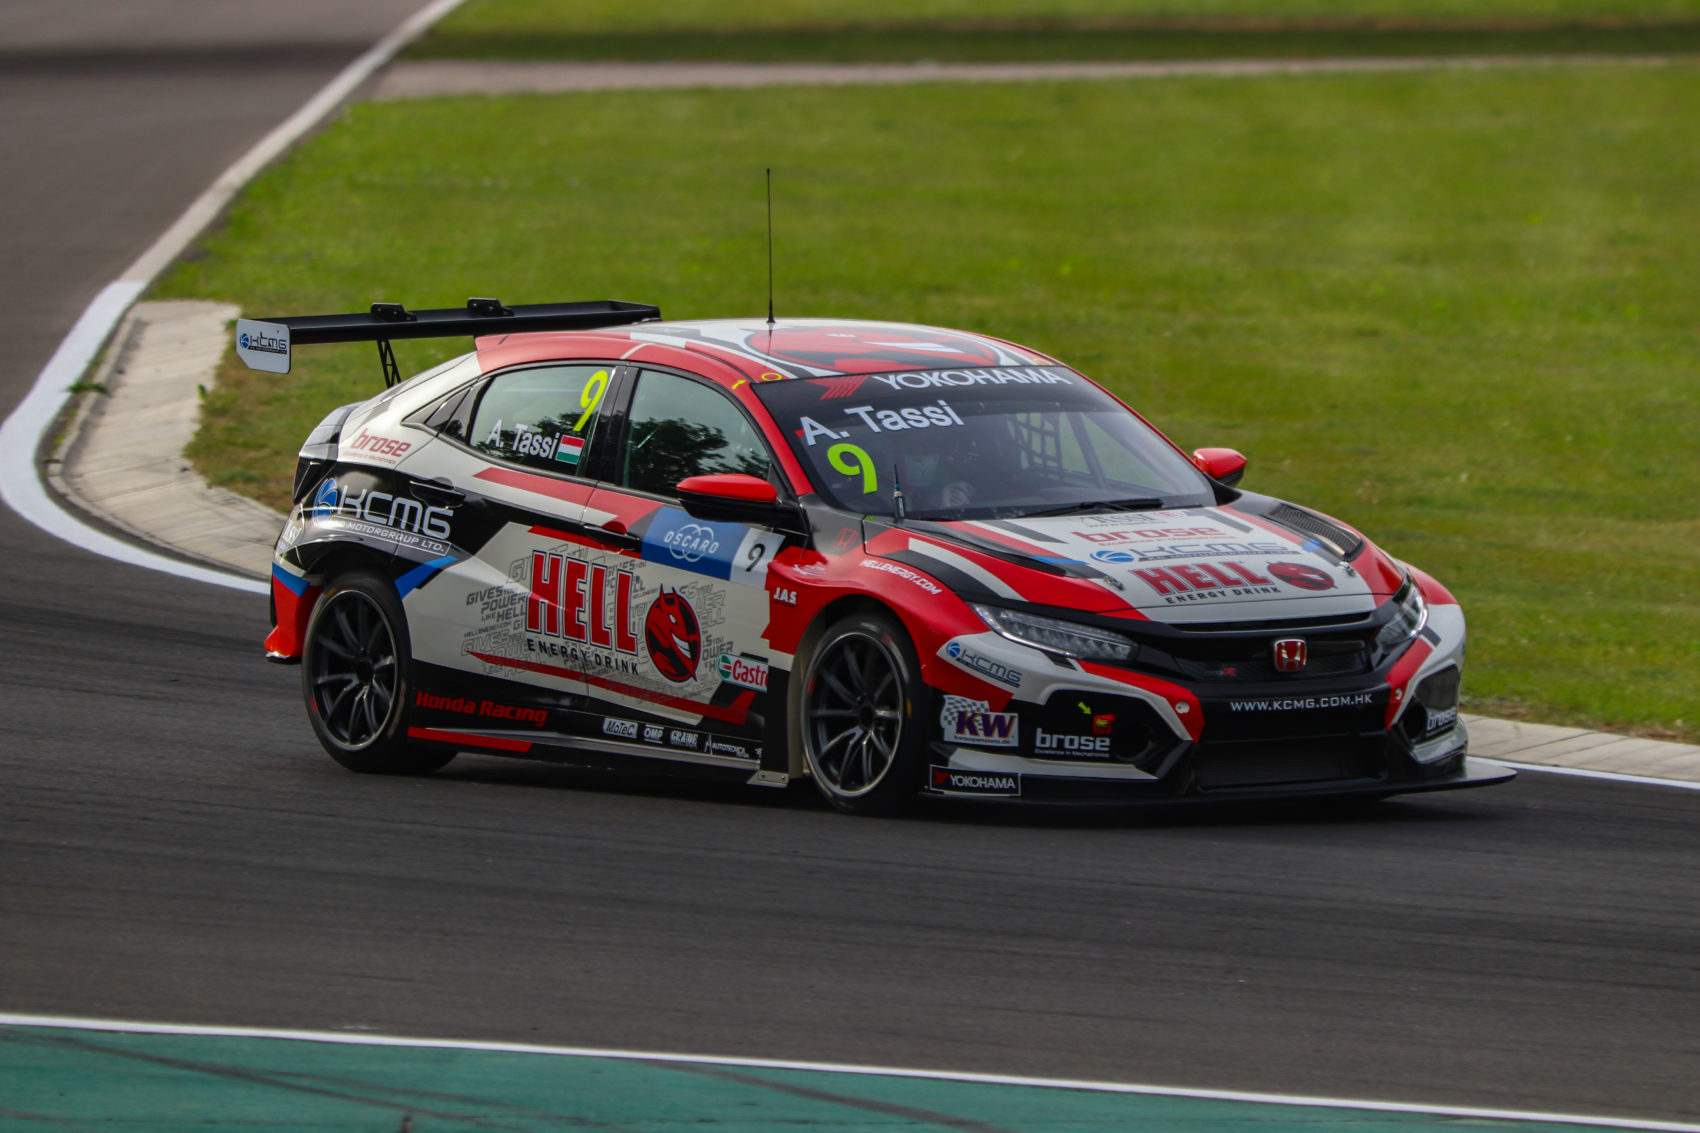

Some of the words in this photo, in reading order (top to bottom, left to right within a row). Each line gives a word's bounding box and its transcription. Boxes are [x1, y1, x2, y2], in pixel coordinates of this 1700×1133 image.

[872, 368, 1073, 391] YOKOHAMA
[572, 370, 608, 432] 9
[800, 416, 850, 446] A.
[843, 399, 966, 433] Tassi
[350, 428, 412, 457] brose
[485, 418, 504, 448] A.
[512, 423, 560, 460] Tassi
[826, 443, 878, 495] 9
[337, 485, 454, 540] KCMG
[348, 522, 420, 545] MOTORGROUP
[420, 539, 445, 552] LTD.
[664, 531, 720, 554] OSCARO
[1071, 527, 1228, 543] brose
[745, 543, 766, 572] 9
[860, 559, 942, 595] HELLENERGY.COM
[1128, 561, 1275, 596] HELL
[466, 586, 505, 606] GIVES
[481, 594, 527, 614] POWER
[526, 550, 638, 656] HELL
[1165, 589, 1227, 604] ENERGY
[1235, 586, 1282, 597] DRINK
[527, 638, 588, 663] ENERGY
[594, 653, 639, 676] DRINK
[961, 649, 1023, 684] KCMG
[416, 691, 477, 715] Honda
[478, 700, 549, 727] Racing
[1230, 693, 1373, 712] WWW.KCMG.COM.HK
[606, 720, 634, 738] MoTeC
[644, 728, 664, 741] OMP
[955, 710, 1017, 739] KW
[1426, 710, 1456, 730] brose
[1036, 728, 1111, 751] brose
[949, 774, 1016, 789] YOKOHAMA
